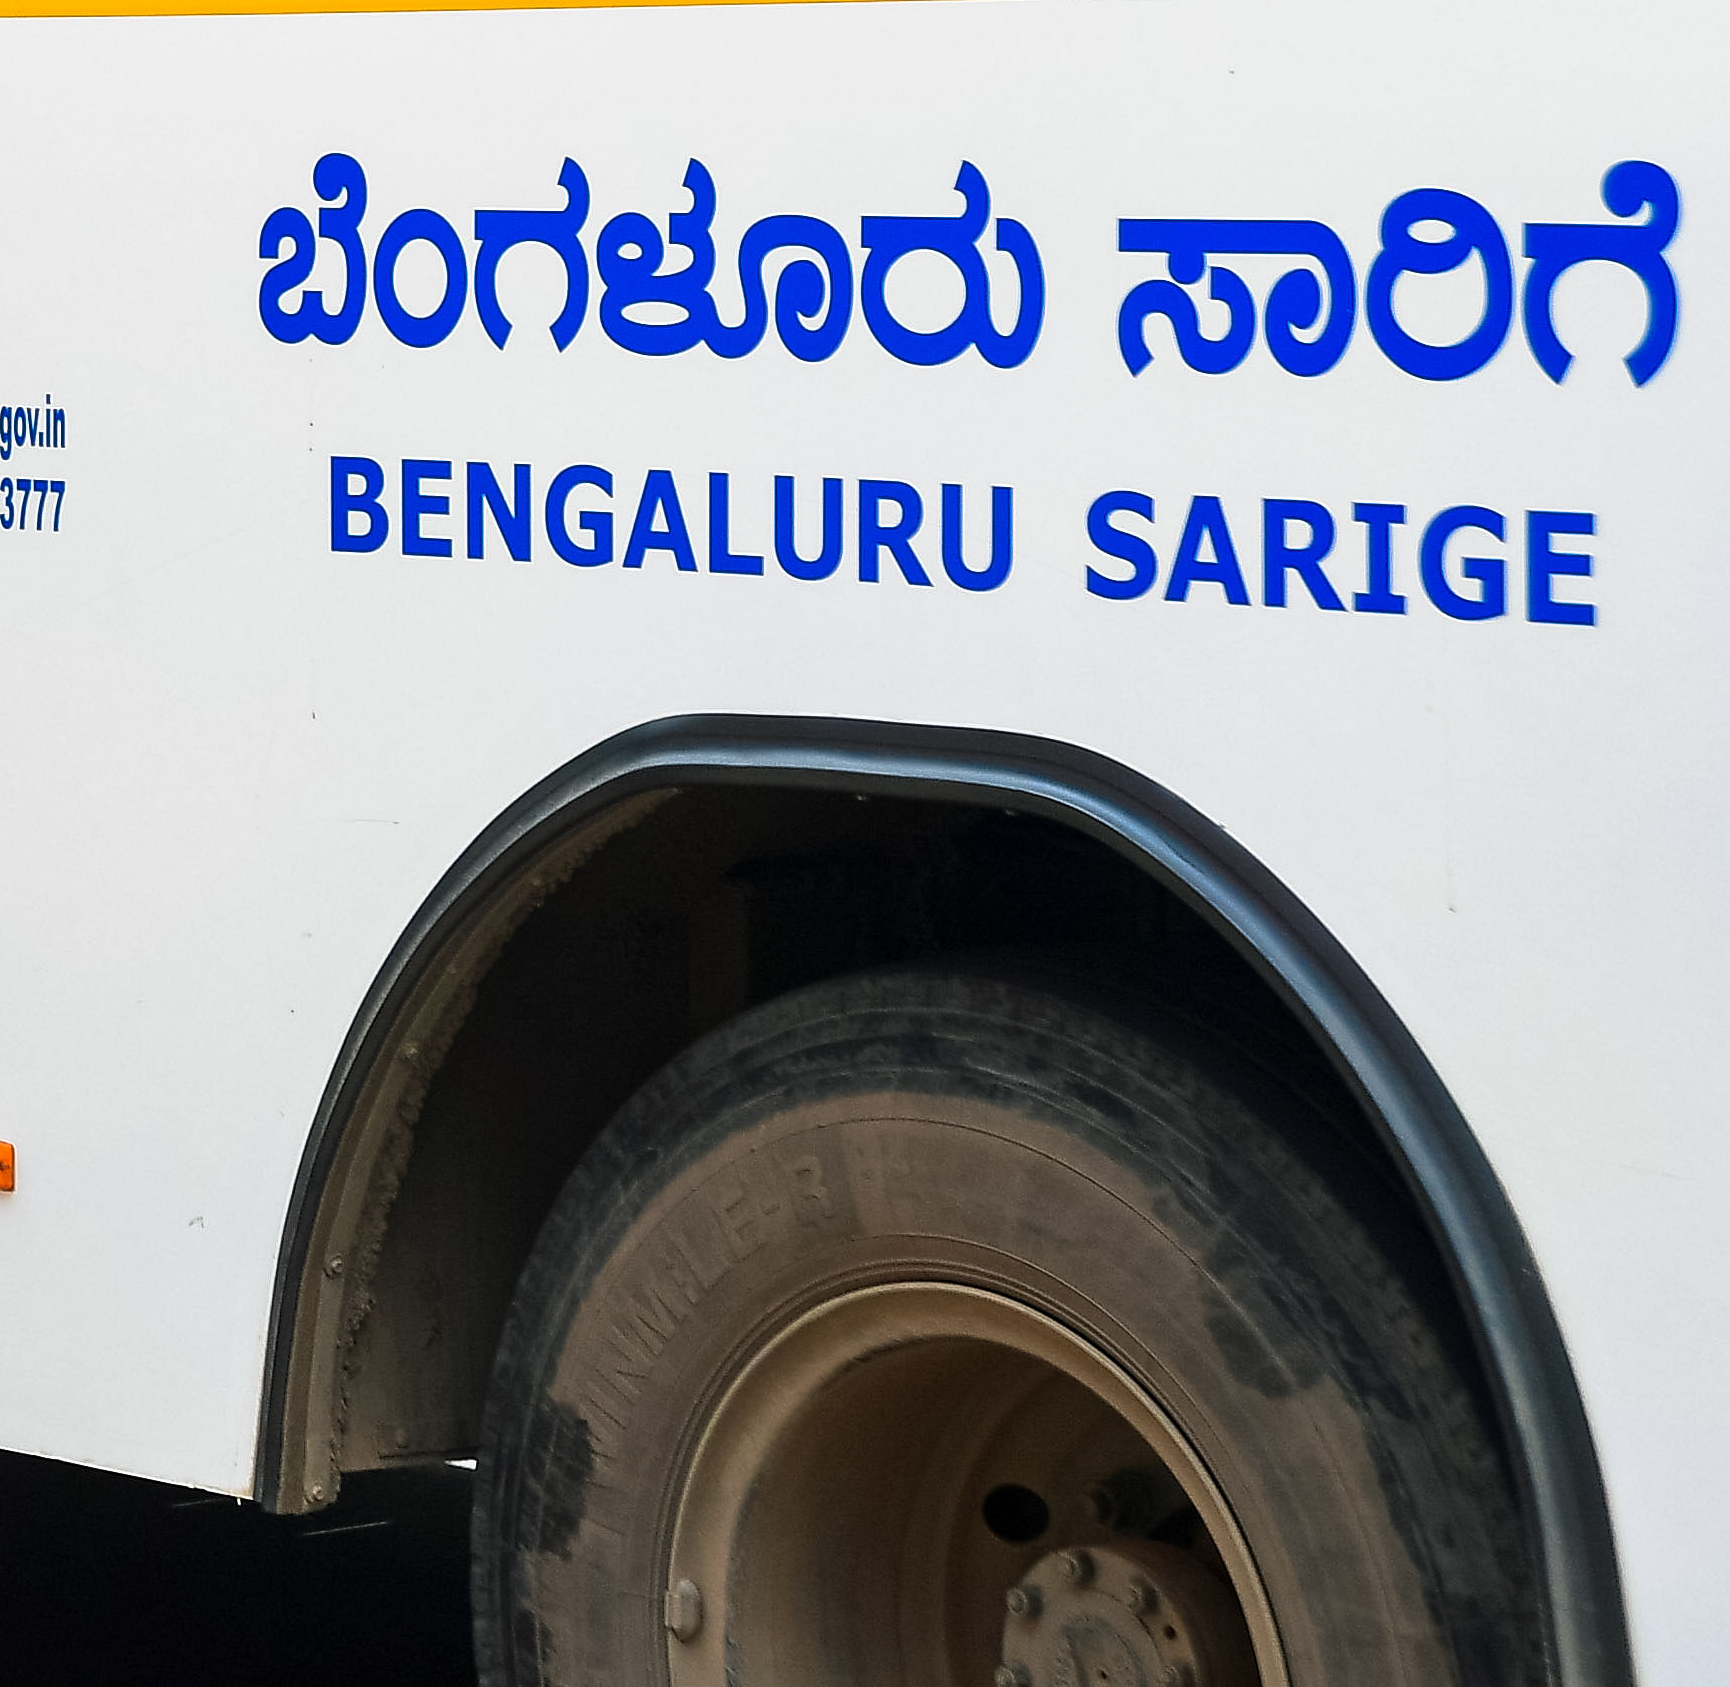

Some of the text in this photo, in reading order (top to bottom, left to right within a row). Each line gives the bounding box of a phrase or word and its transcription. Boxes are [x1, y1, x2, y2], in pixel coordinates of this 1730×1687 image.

[257, 151, 1682, 387] ಬೆಂಗಳೂರು ಸಾರಿಗೆ
[328, 455, 1599, 628] BENGALURU SARIGE
